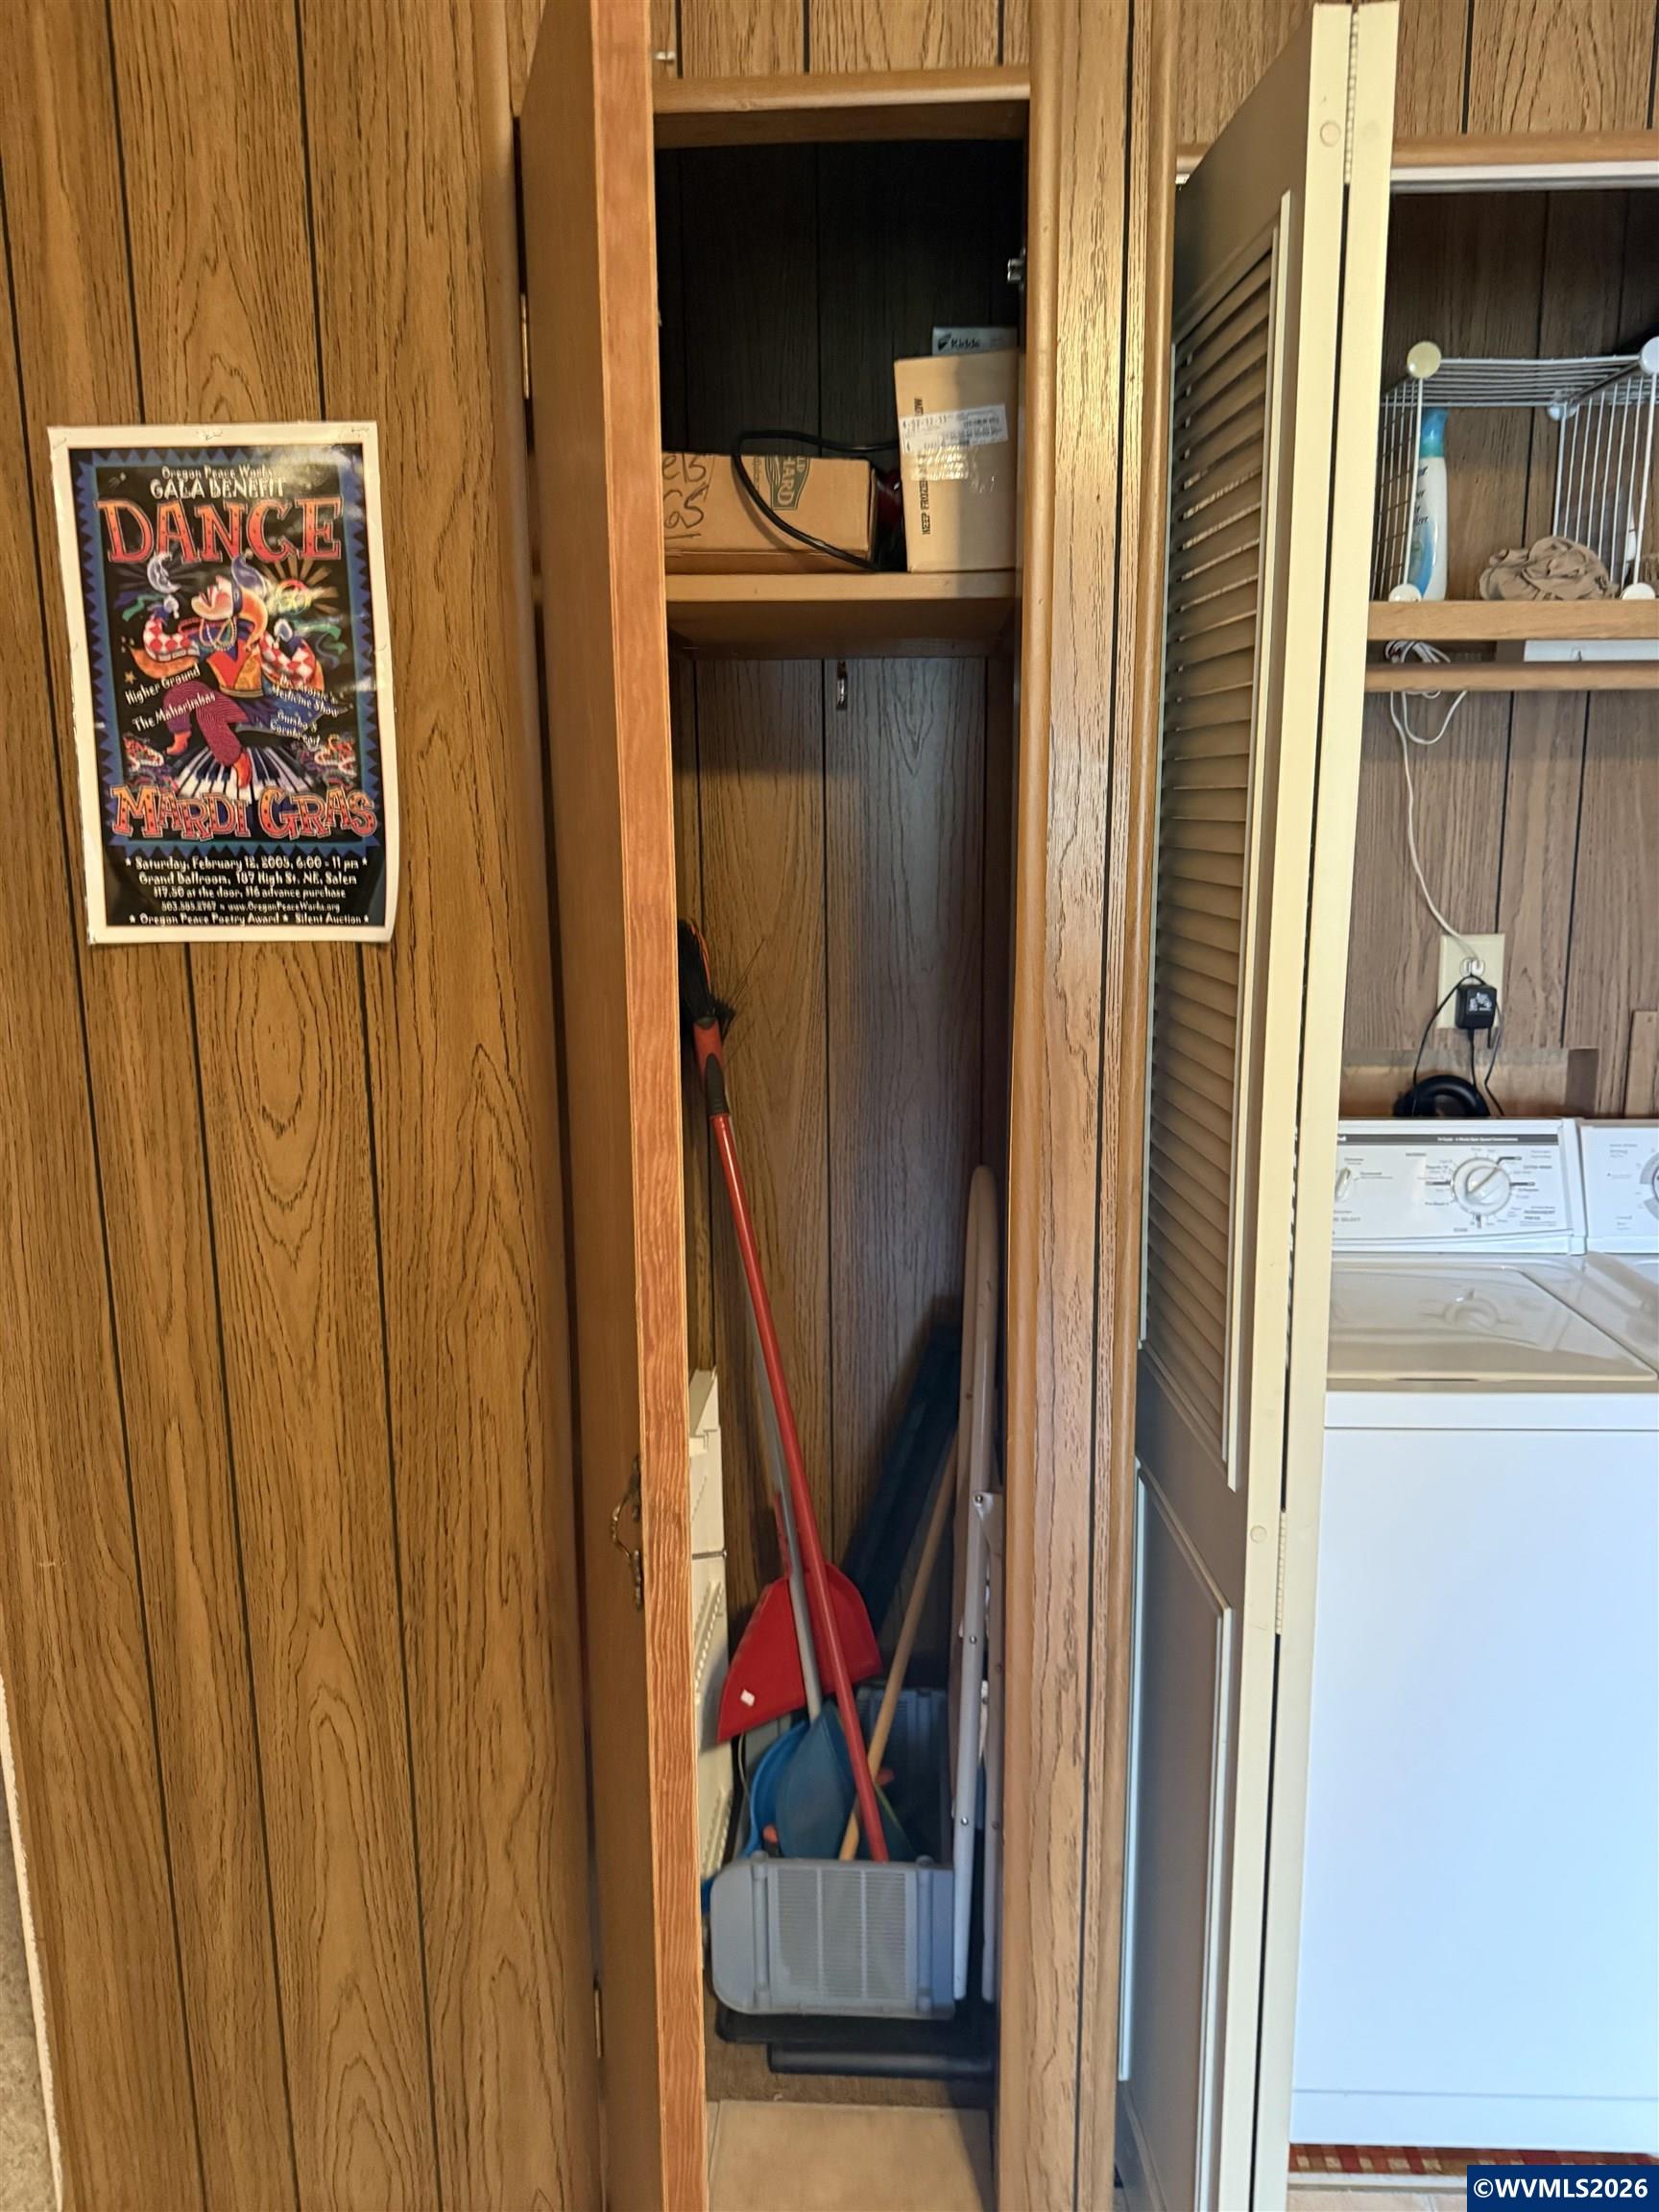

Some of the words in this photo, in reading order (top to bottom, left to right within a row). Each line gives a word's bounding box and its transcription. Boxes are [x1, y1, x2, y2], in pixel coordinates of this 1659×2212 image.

[161, 466, 202, 481] Oregon
[204, 464, 236, 479] Peace
[150, 479, 205, 499] GALA
[208, 476, 285, 498] BENEFIT
[96, 495, 343, 564] DANCE
[125, 684, 161, 706] Higher
[160, 661, 201, 689] Ground
[313, 699, 338, 718] Show
[132, 714, 156, 732] The
[110, 784, 251, 842] MARDI
[257, 784, 378, 841] GRAS
[135, 855, 190, 873] Saturday,
[192, 855, 243, 873] February
[296, 855, 323, 870] 6:00
[332, 855, 341, 869] 11
[344, 859, 359, 873] pm
[138, 871, 174, 885] Grand
[177, 871, 231, 885] Ballroom,
[257, 871, 283, 888] High
[284, 871, 300, 884] St.
[302, 871, 324, 885] NE,
[325, 871, 358, 885] Salem
[186, 888, 196, 899] at
[198, 885, 215, 899] the
[216, 885, 243, 900] door,
[261, 885, 301, 899] advance
[302, 885, 346, 901] purchase
[139, 912, 179, 926] Oregon
[180, 912, 209, 925] Peace
[211, 912, 245, 926] Poetry
[247, 912, 279, 925] Award
[295, 912, 324, 925] Silent
[325, 912, 362, 925] Auction
